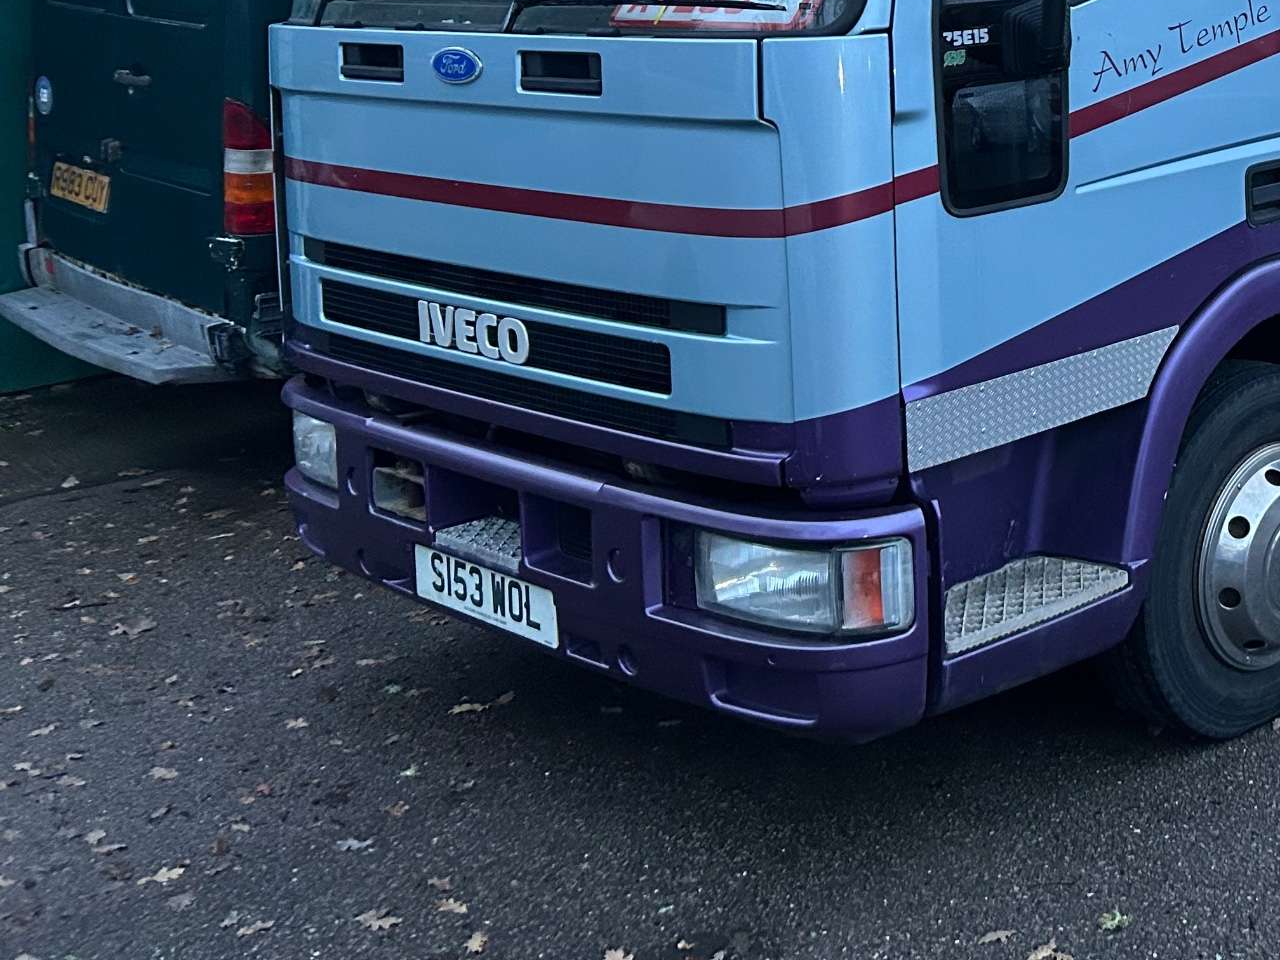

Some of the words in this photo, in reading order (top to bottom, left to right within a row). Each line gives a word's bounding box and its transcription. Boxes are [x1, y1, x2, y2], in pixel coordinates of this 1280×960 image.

[440, 54, 468, 75] Ford
[1092, 43, 1163, 93] Amy
[417, 299, 530, 365] IVECO
[430, 551, 484, 608] S153
[490, 572, 541, 631] WOL
